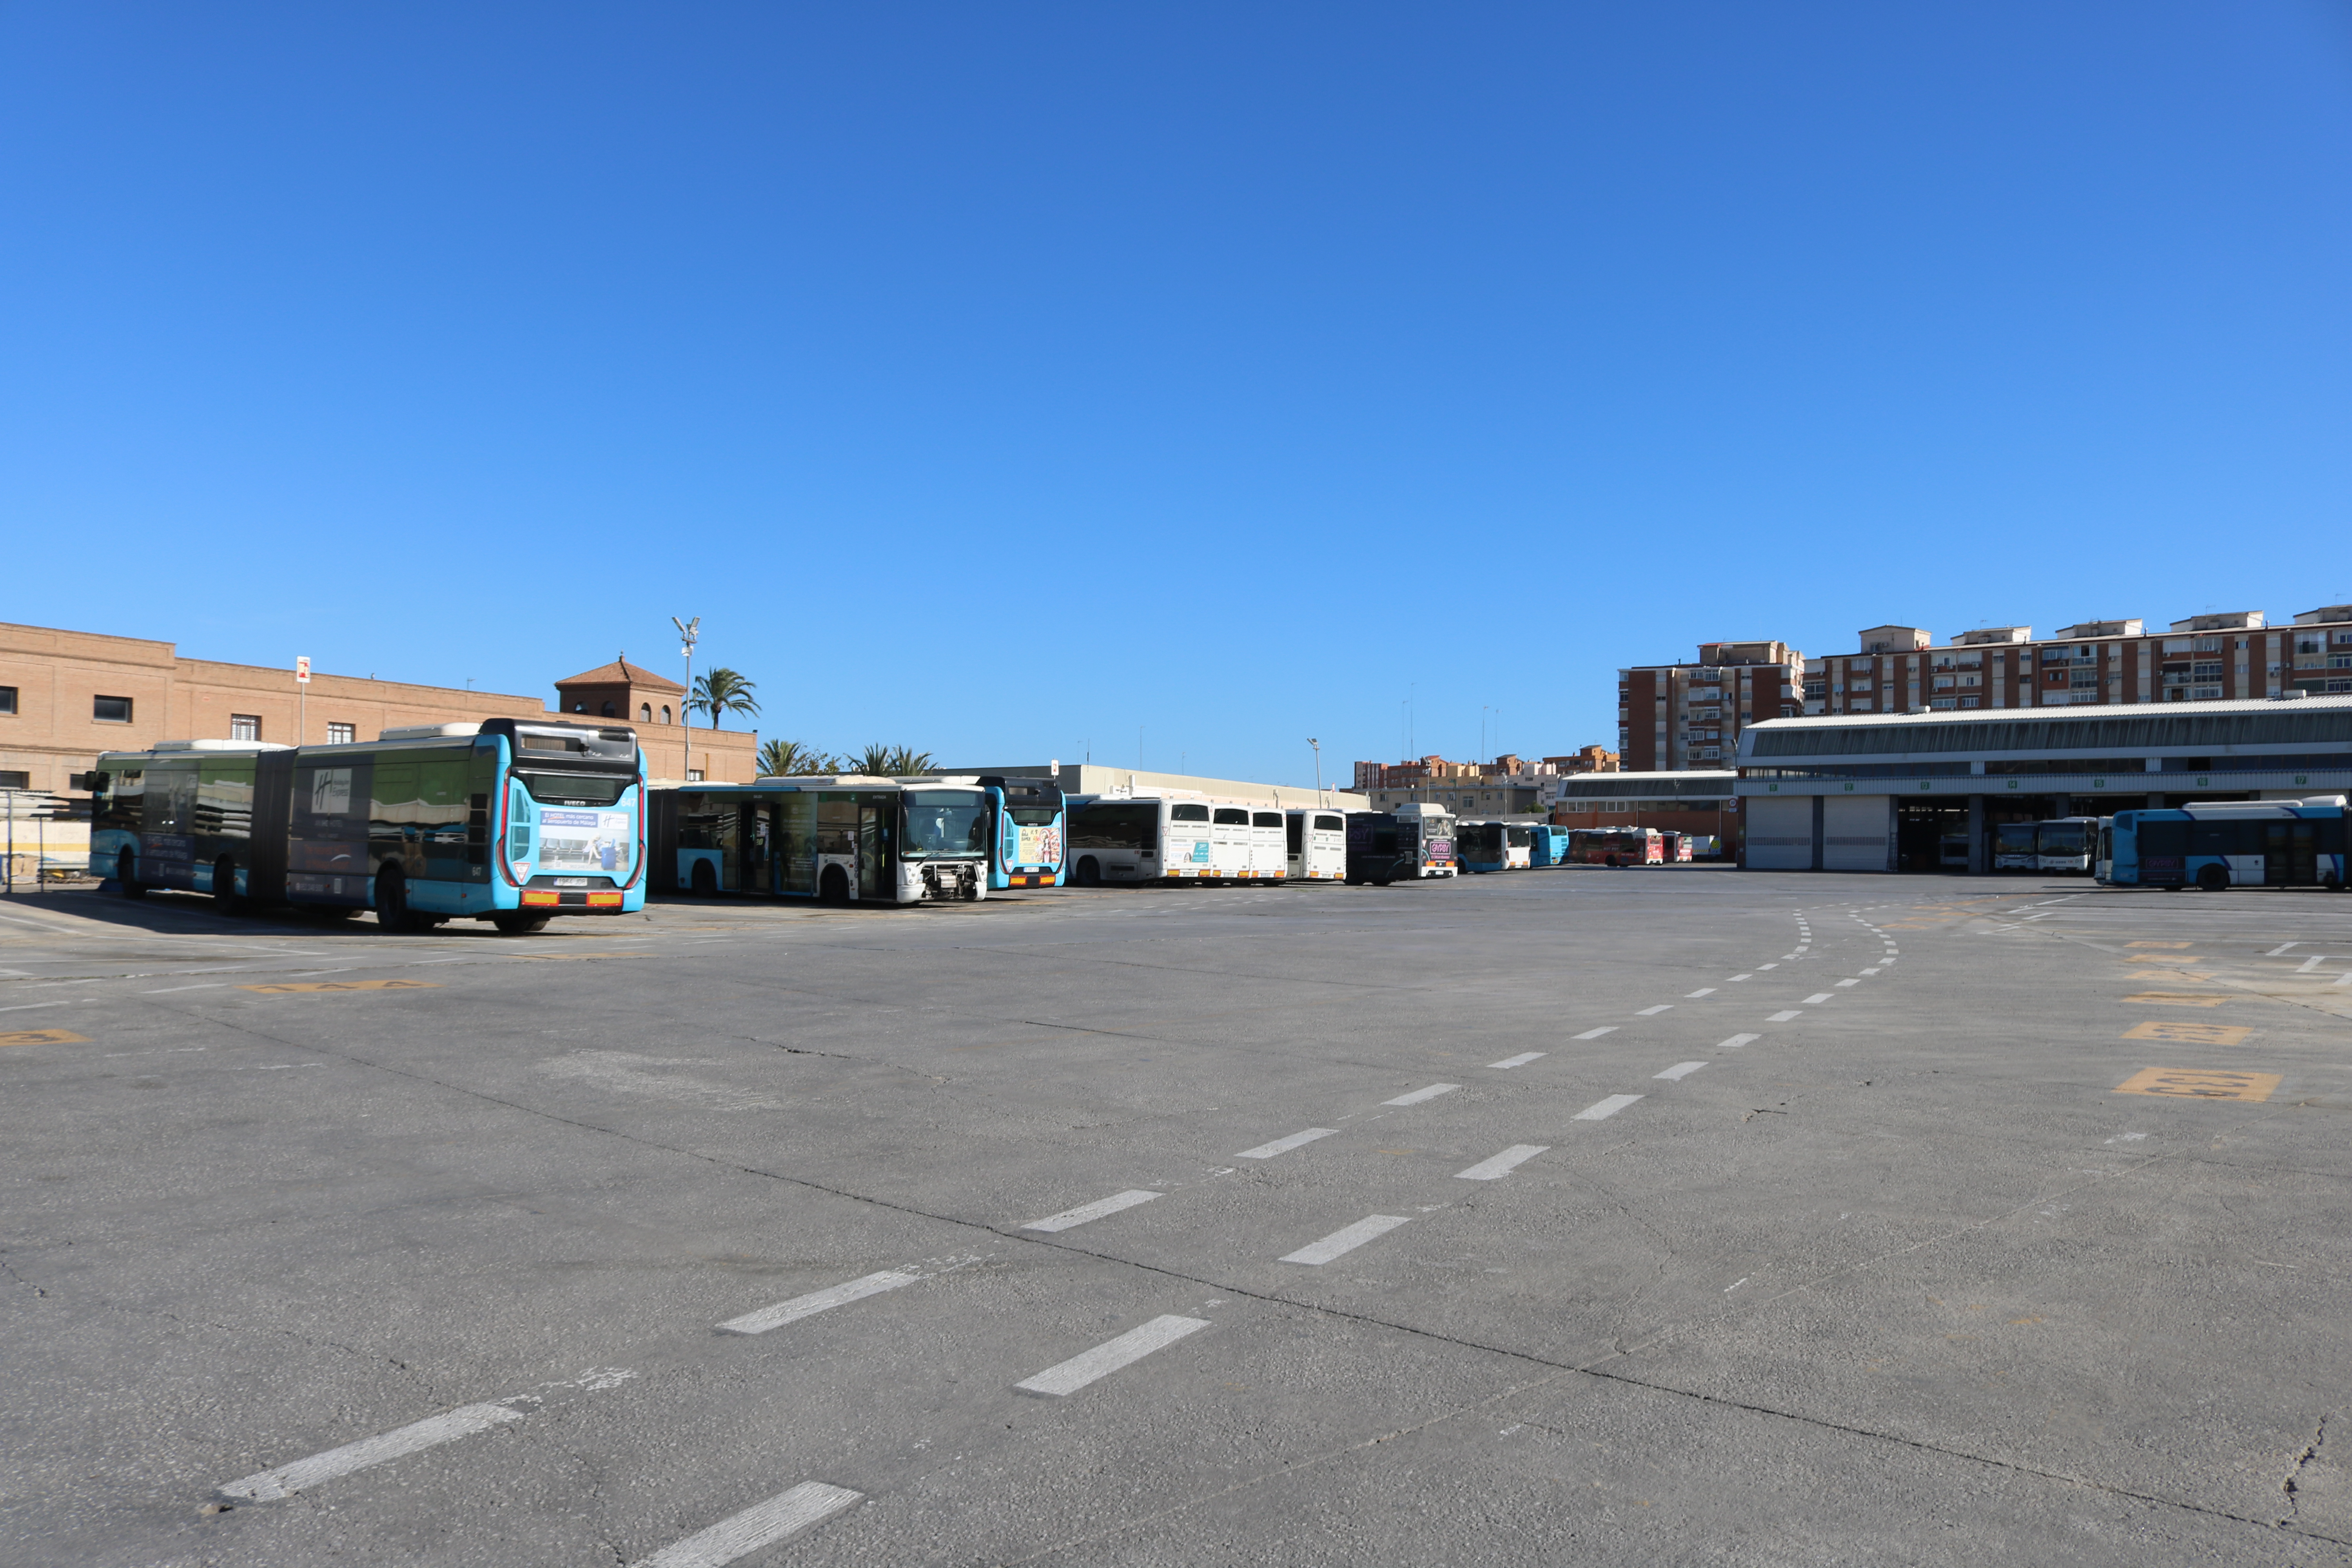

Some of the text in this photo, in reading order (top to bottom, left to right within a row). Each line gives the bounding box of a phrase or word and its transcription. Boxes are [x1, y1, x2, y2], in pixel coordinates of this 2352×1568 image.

[621, 798, 637, 807] 647
[1432, 843, 1449, 852] GYPSY
[2149, 859, 2175, 867] GYPSY
